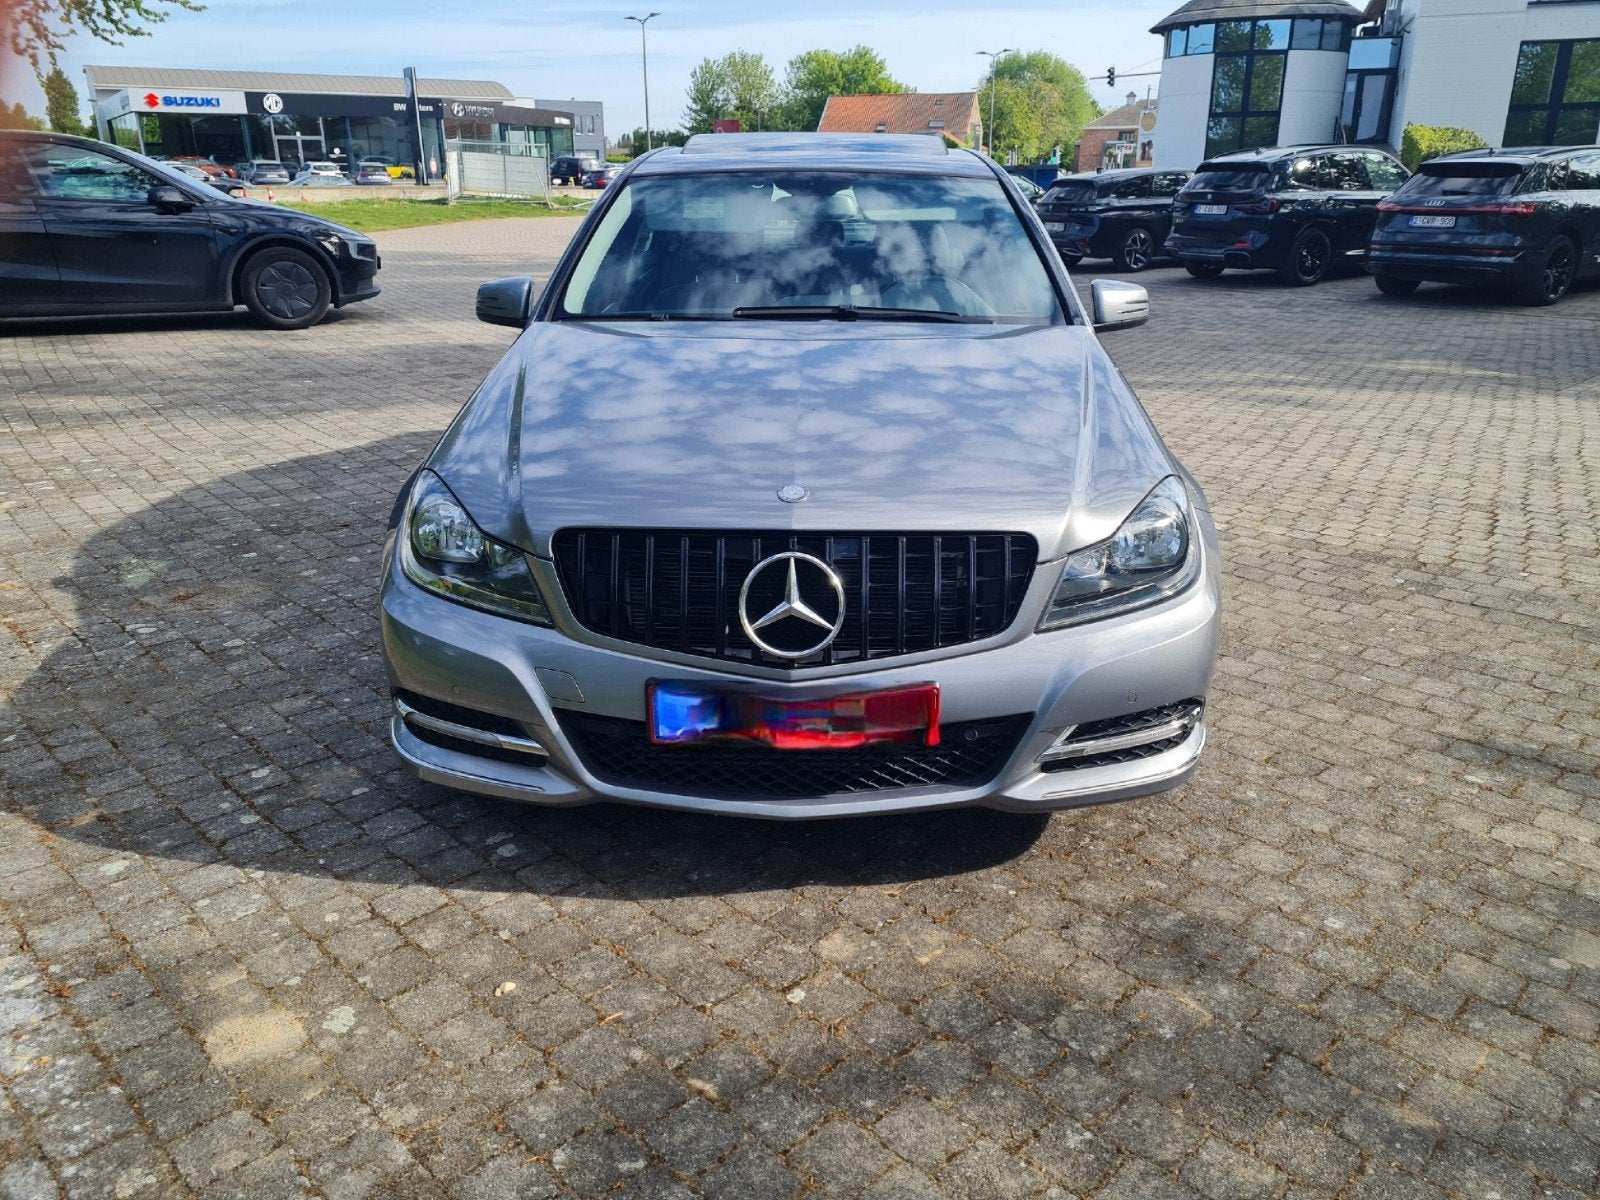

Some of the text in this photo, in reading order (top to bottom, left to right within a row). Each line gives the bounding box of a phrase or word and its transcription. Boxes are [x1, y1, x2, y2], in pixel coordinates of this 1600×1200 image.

[163, 95, 220, 107] SUZUKI
[264, 95, 282, 112] MG
[465, 105, 495, 118] HYUNDAI
